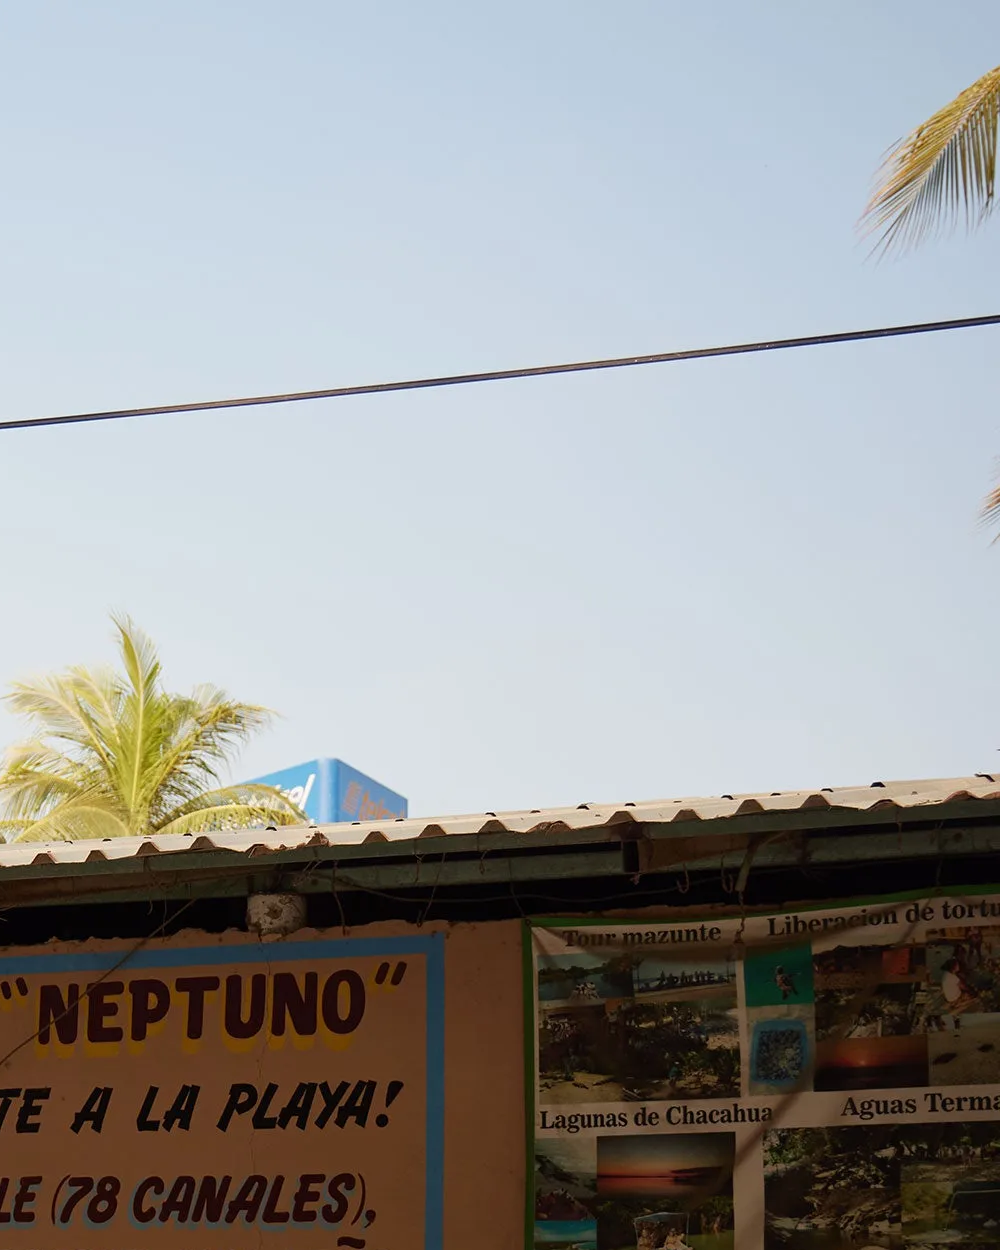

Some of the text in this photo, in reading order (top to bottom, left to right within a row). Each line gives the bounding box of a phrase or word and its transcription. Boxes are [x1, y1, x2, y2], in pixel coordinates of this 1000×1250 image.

[767, 909, 897, 937] Liberacion
[905, 903, 935, 923] de
[563, 926, 722, 947] Tour mazunte
[69, 1086, 115, 1134] A
[136, 1085, 200, 1132] LA
[217, 1080, 404, 1131] PLAYA!
[540, 1103, 773, 1133] Lagunas de Chacahua
[841, 1093, 1000, 1120] Aguas Terma
[51, 1175, 120, 1227] (78
[132, 1173, 377, 1229] CANALES),
